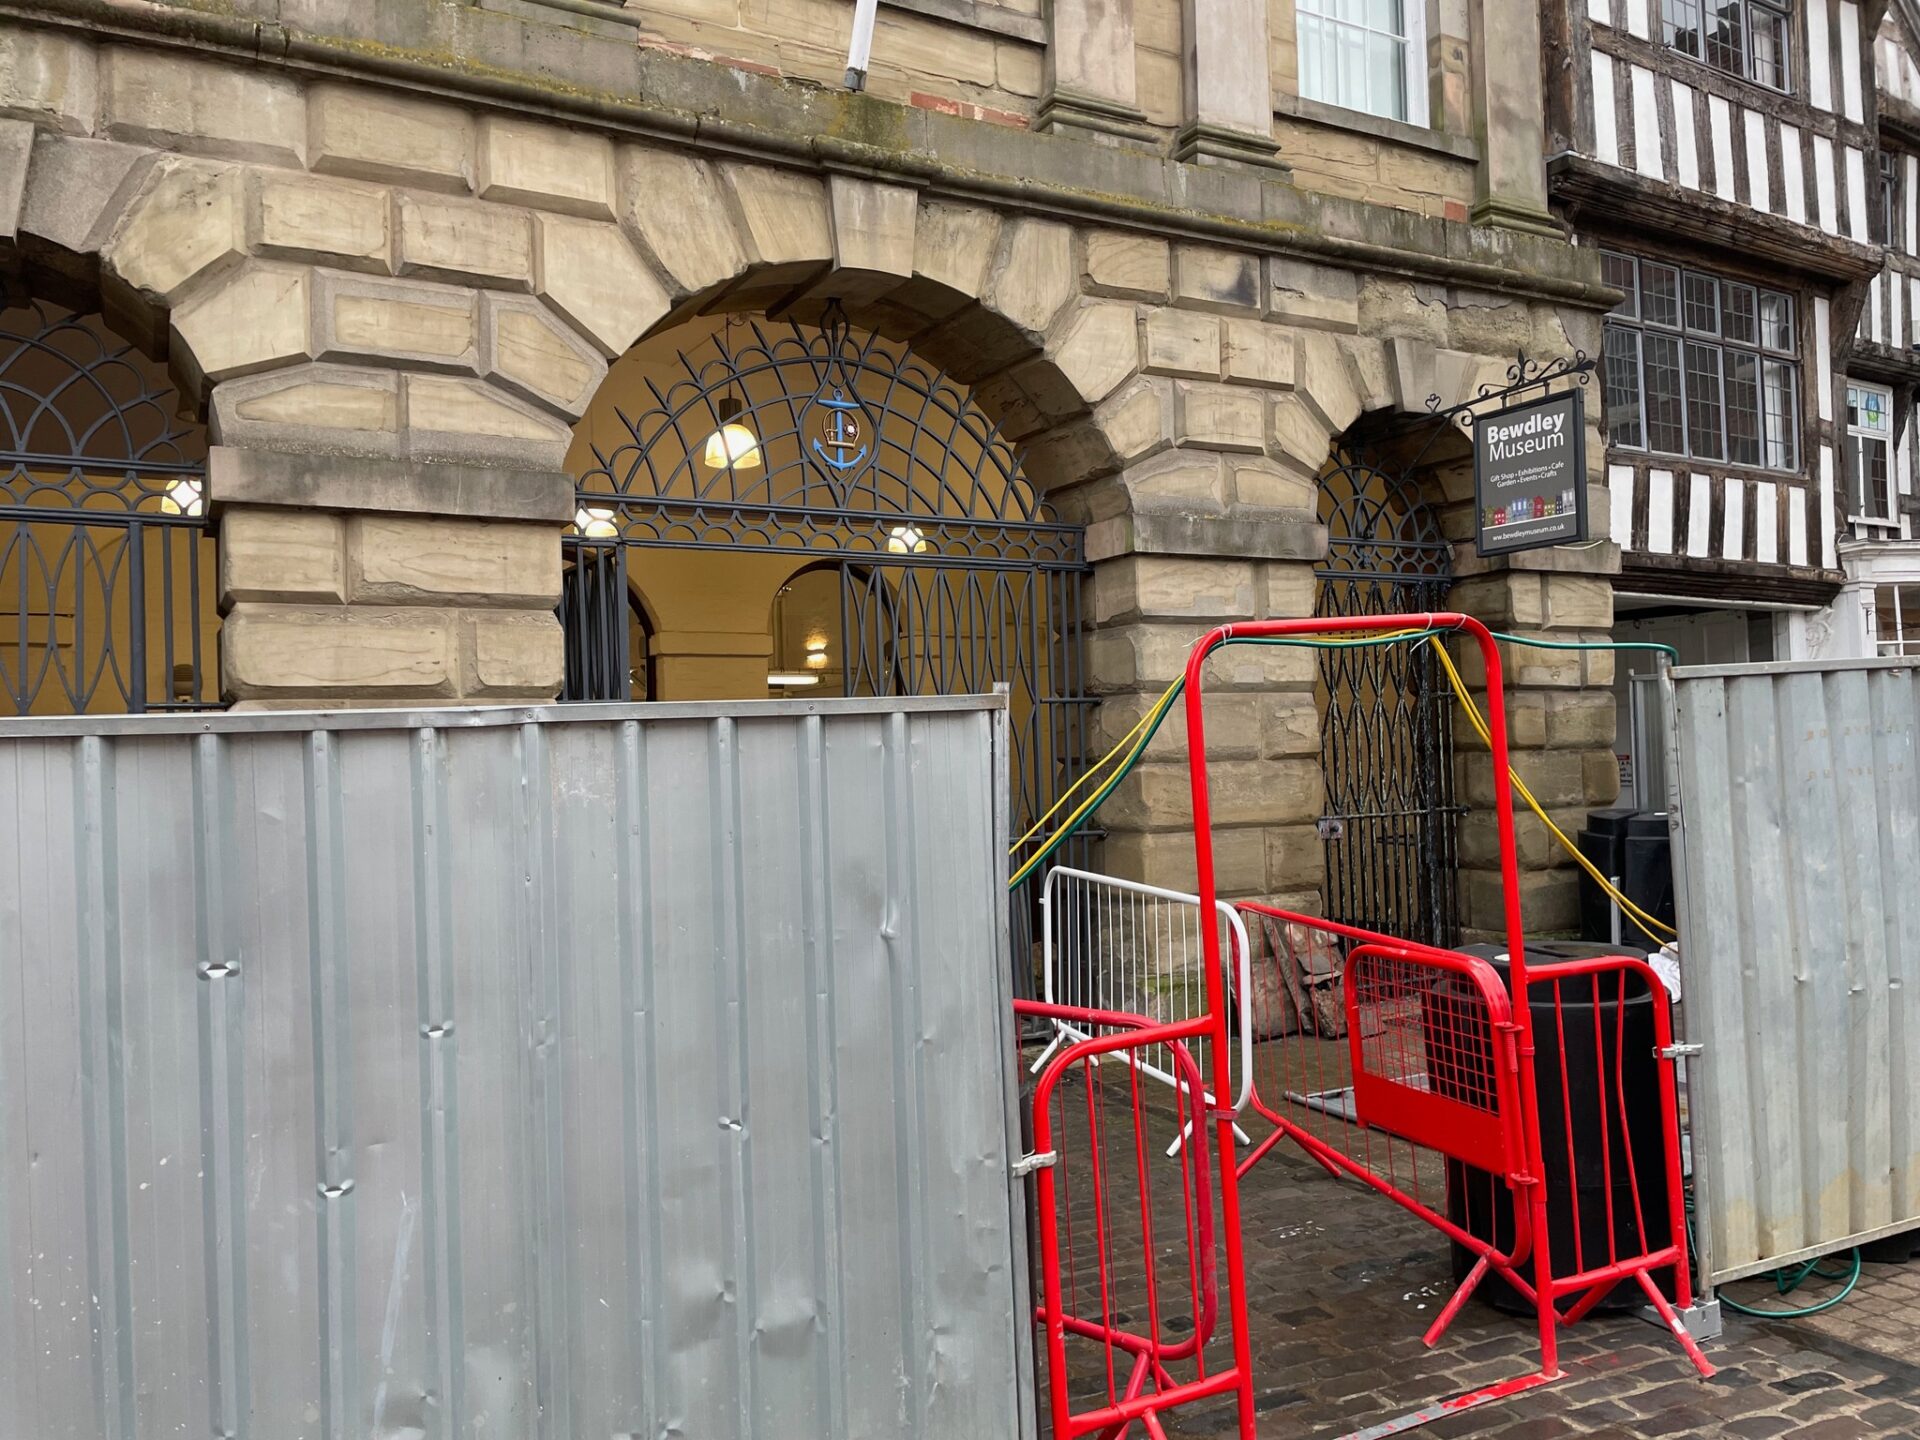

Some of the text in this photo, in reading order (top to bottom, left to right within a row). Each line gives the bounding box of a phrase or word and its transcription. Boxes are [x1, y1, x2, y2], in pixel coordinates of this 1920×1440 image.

[1487, 413, 1565, 444] Bewdley
[1489, 432, 1564, 462] Museum
[1490, 474, 1499, 482] Gift
[1500, 472, 1514, 480] Shop
[1518, 465, 1548, 476] Exhibitions
[1497, 470, 1557, 487] Garden Events Crafts
